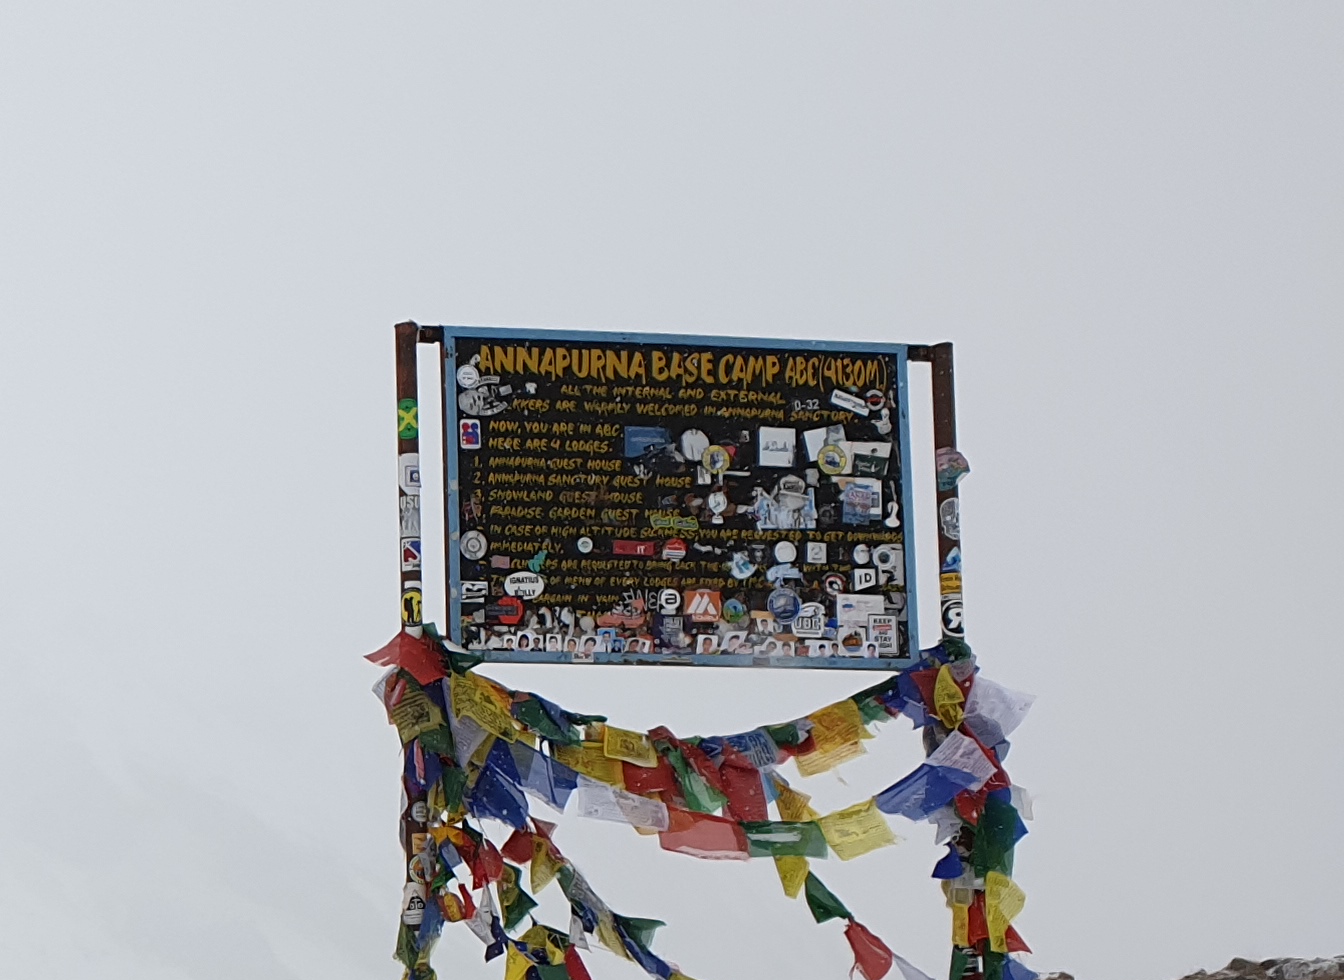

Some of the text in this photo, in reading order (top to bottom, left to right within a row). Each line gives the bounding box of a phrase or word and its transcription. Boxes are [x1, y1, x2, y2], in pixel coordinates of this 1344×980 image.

[479, 344, 647, 385] ANNAPURNA
[651, 351, 715, 384] BASE
[718, 353, 780, 388] CAMP
[560, 384, 786, 405] ALL THE INTERNAL AND EXTERNAL
[555, 400, 578, 413] ARE
[584, 400, 631, 416] WARMLY
[636, 402, 698, 417] WELCOMED
[488, 420, 521, 434] NOW,
[524, 421, 548, 433] YOU
[551, 421, 574, 436] ARE
[579, 422, 592, 434] IN
[488, 437, 612, 456] HERE ARE 4 LODGES.
[488, 456, 547, 471] ANNAPURNA
[549, 457, 583, 470] GUEST
[587, 459, 623, 472] HOUSE
[487, 473, 545, 487] ANNAPURNA
[613, 474, 648, 488] GUEST
[655, 477, 692, 489] HOUSE
[488, 490, 553, 502] SNOWLAND
[490, 506, 543, 519] PARADISE
[548, 506, 596, 519] GARDEN
[600, 508, 639, 520] GUEST
[489, 525, 501, 535] IN
[504, 525, 533, 536] CASE
[534, 525, 548, 535] OF
[550, 527, 578, 538] HIGH
[579, 526, 637, 538] ALTITUDE
[741, 530, 803, 542] REQUESTED
[806, 532, 819, 542] TO
[820, 531, 845, 542] GET
